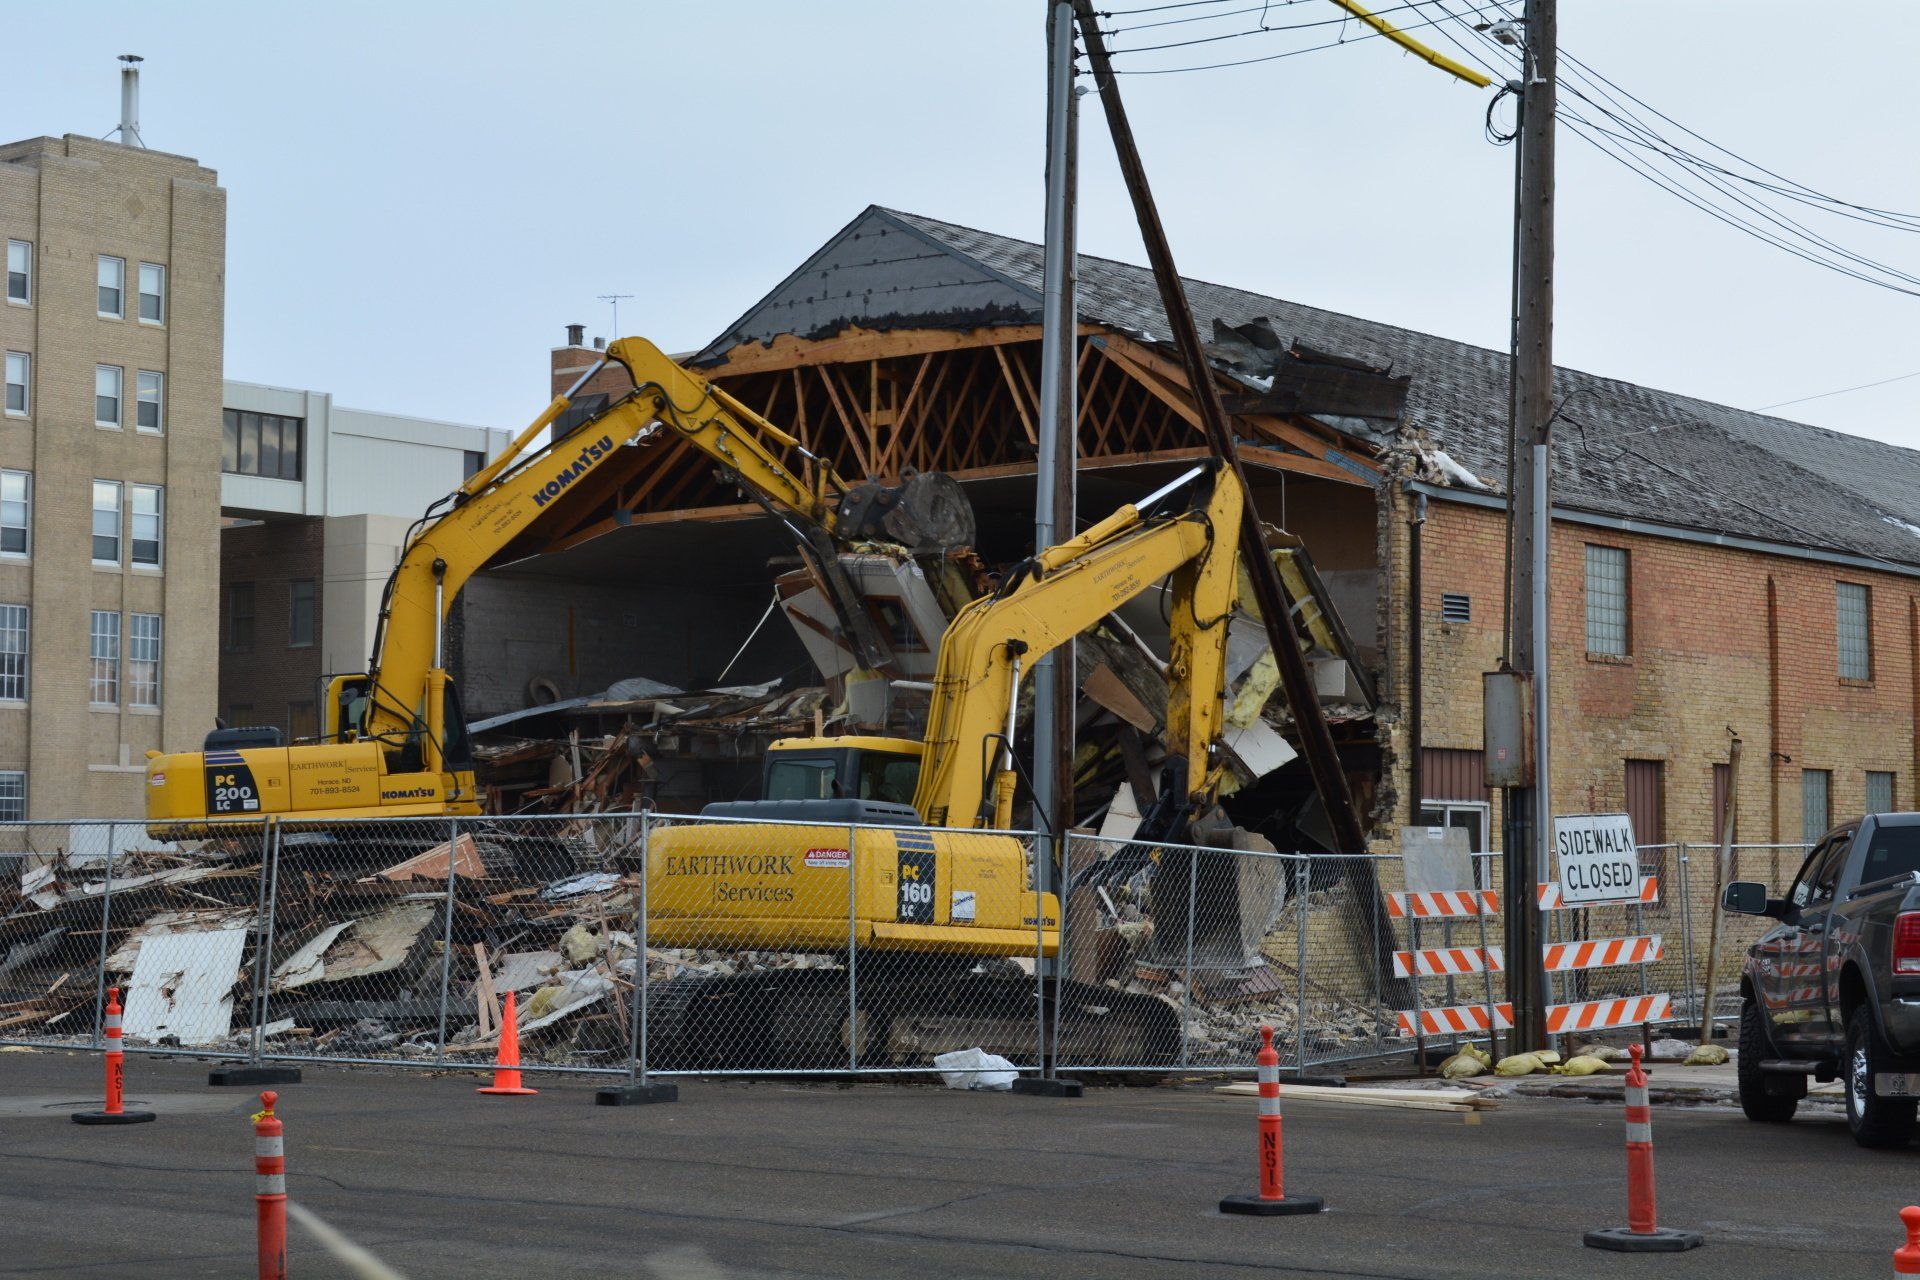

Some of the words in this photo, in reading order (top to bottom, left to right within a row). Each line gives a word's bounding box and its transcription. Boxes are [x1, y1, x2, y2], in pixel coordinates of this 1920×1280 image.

[532, 435, 614, 507] KOMATSU
[290, 761, 344, 771] EARTHWORK
[347, 765, 377, 773] Services
[215, 774, 235, 787] PC
[215, 786, 252, 801] 200
[382, 787, 435, 799] KOMATSU
[216, 800, 231, 811] LC
[1559, 828, 1632, 856] SIDEWALK
[816, 851, 848, 859] DANGER
[666, 855, 795, 876] EARTHWORK
[902, 864, 919, 880] PC
[1567, 862, 1633, 890] CLOSED
[717, 881, 794, 902] Services
[901, 882, 932, 904] 160
[901, 904, 914, 917] LC
[1263, 1131, 1276, 1186] NSI
